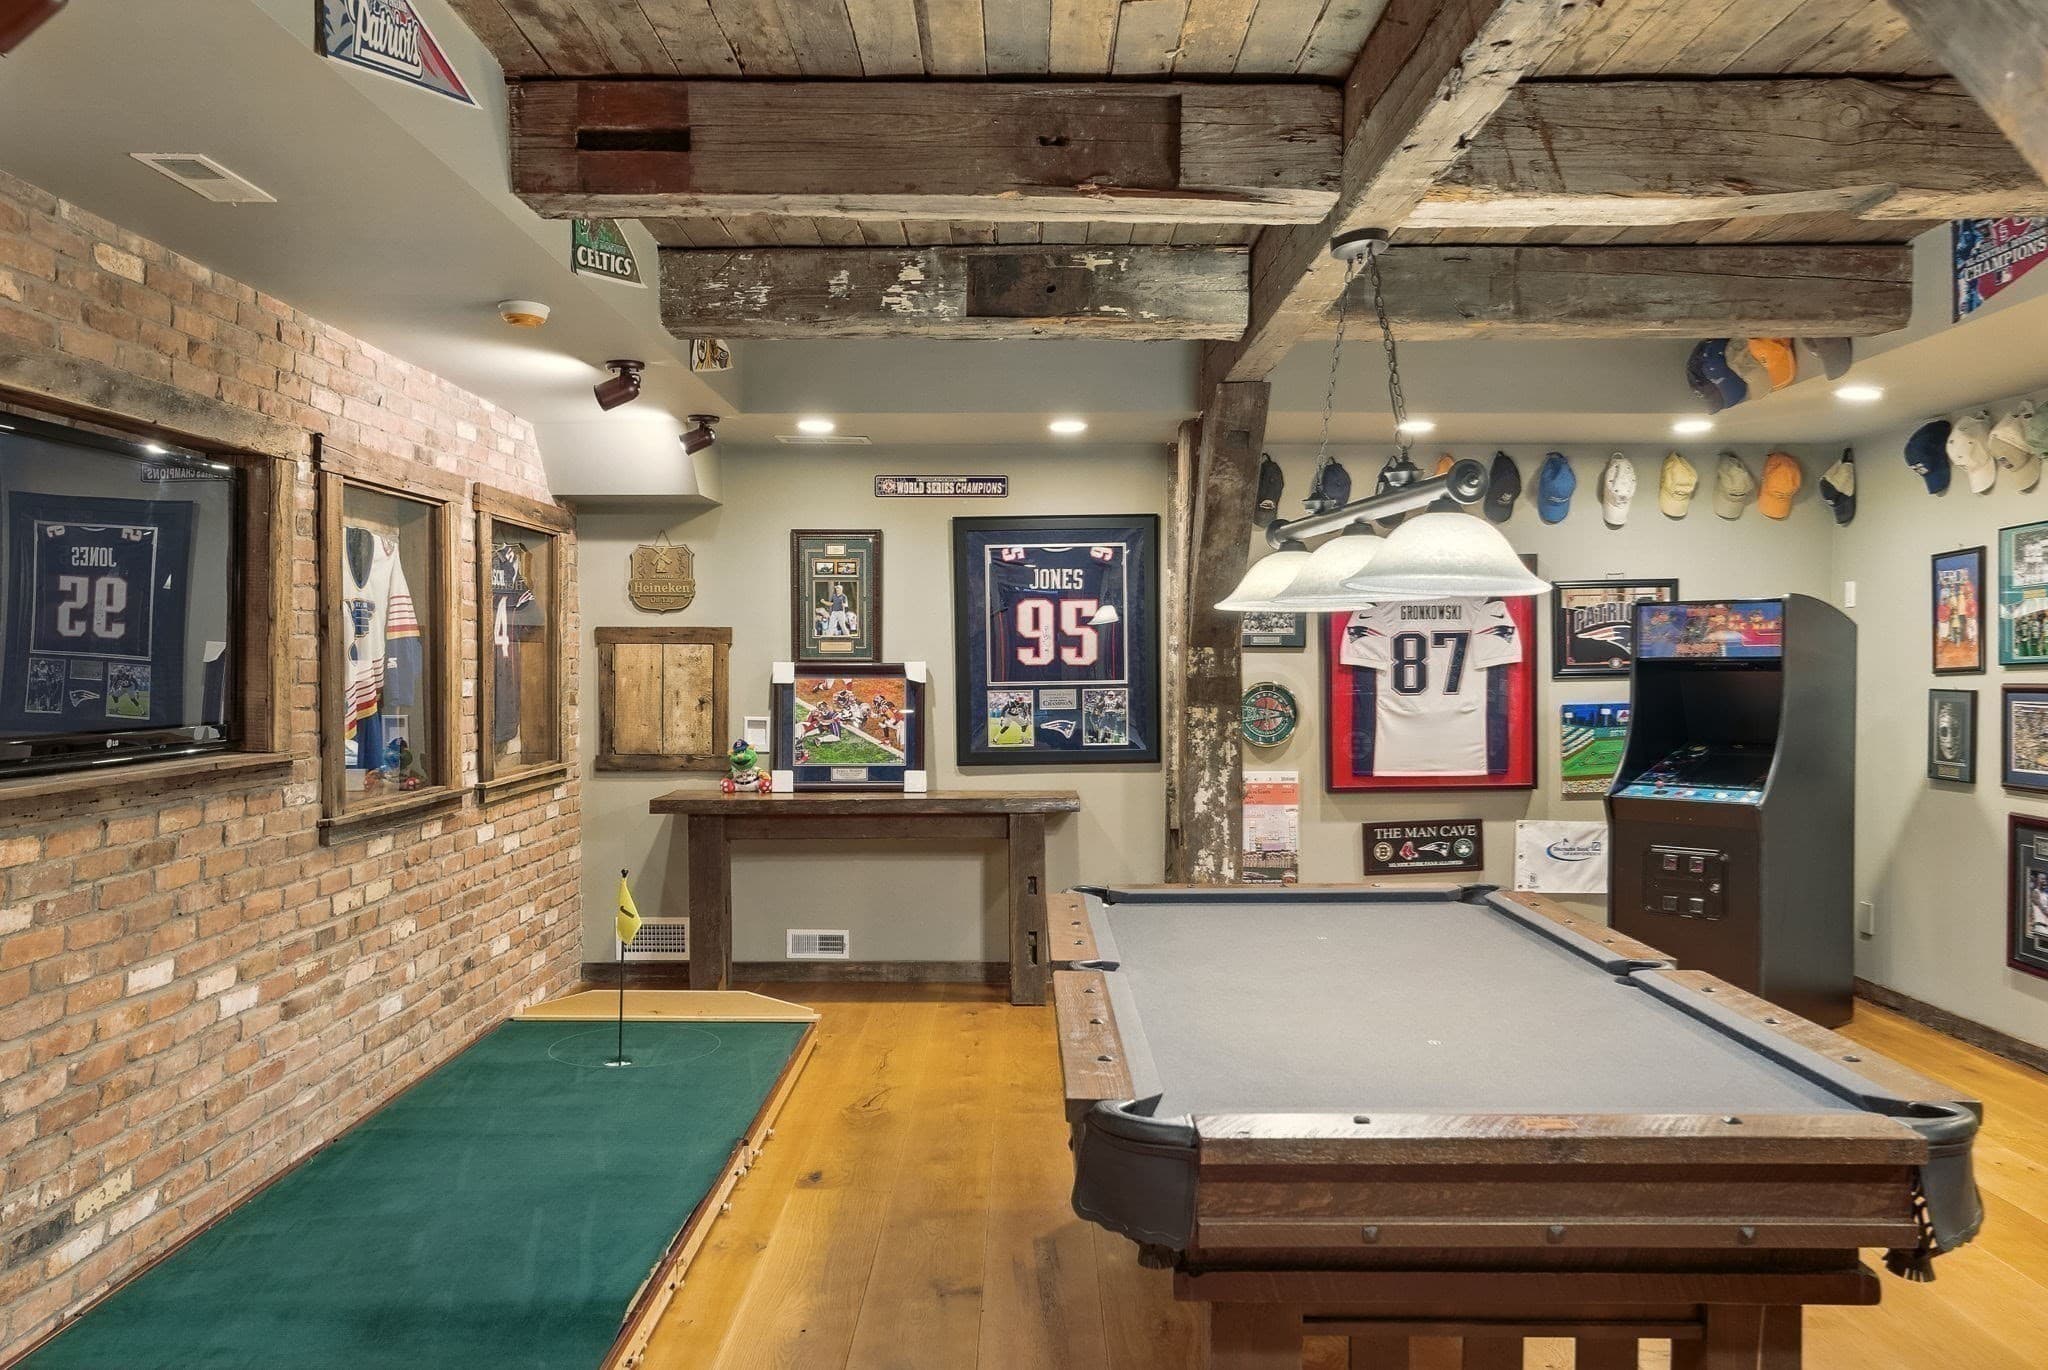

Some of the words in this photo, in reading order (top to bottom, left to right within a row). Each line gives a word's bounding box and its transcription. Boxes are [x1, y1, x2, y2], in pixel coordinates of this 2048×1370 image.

[576, 245, 632, 276] CELTICS
[1965, 237, 2047, 281] CHAMPIONS
[897, 482, 925, 494] WORLD
[926, 482, 954, 494] SERIES
[955, 482, 1002, 494] CHAMPIONS
[634, 582, 690, 593] Heineken
[1029, 568, 1083, 590] JONES
[1400, 605, 1462, 620] GRONKOWSKI
[1016, 598, 1099, 666] 95
[1390, 630, 1472, 696] 87
[1374, 828, 1401, 840] THE
[1404, 826, 1437, 838] MAN
[1440, 825, 1477, 837] CAVE
